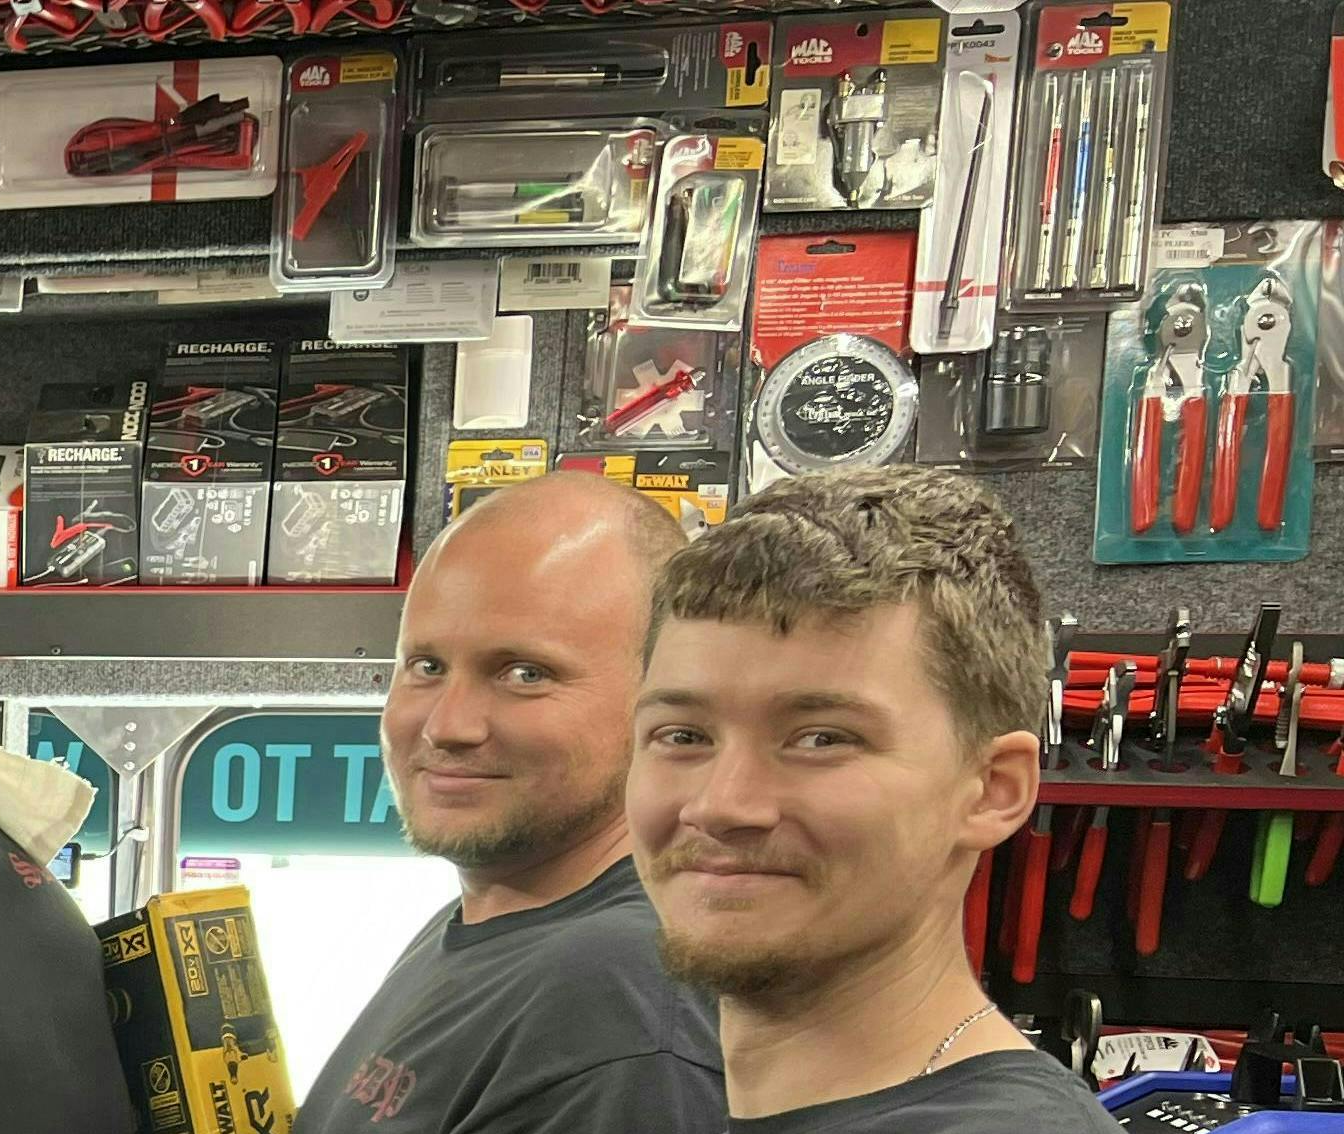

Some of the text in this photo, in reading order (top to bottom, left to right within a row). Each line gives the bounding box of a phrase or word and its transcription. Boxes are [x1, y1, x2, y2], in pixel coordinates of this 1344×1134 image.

[792, 37, 833, 56] MAC
[1067, 31, 1103, 48] MAC
[1067, 46, 1103, 54] TOOLS
[792, 54, 833, 64] TOOLS
[299, 65, 330, 81] MAC
[177, 342, 273, 354] RECHARGE.
[801, 375, 835, 386] ANGLE
[128, 381, 147, 410] NOCO
[48, 448, 123, 462] RECHARGE.
[189, 459, 199, 470] 1
[321, 458, 330, 469] 1
[122, 926, 147, 956] XR
[179, 925, 195, 953] XR
